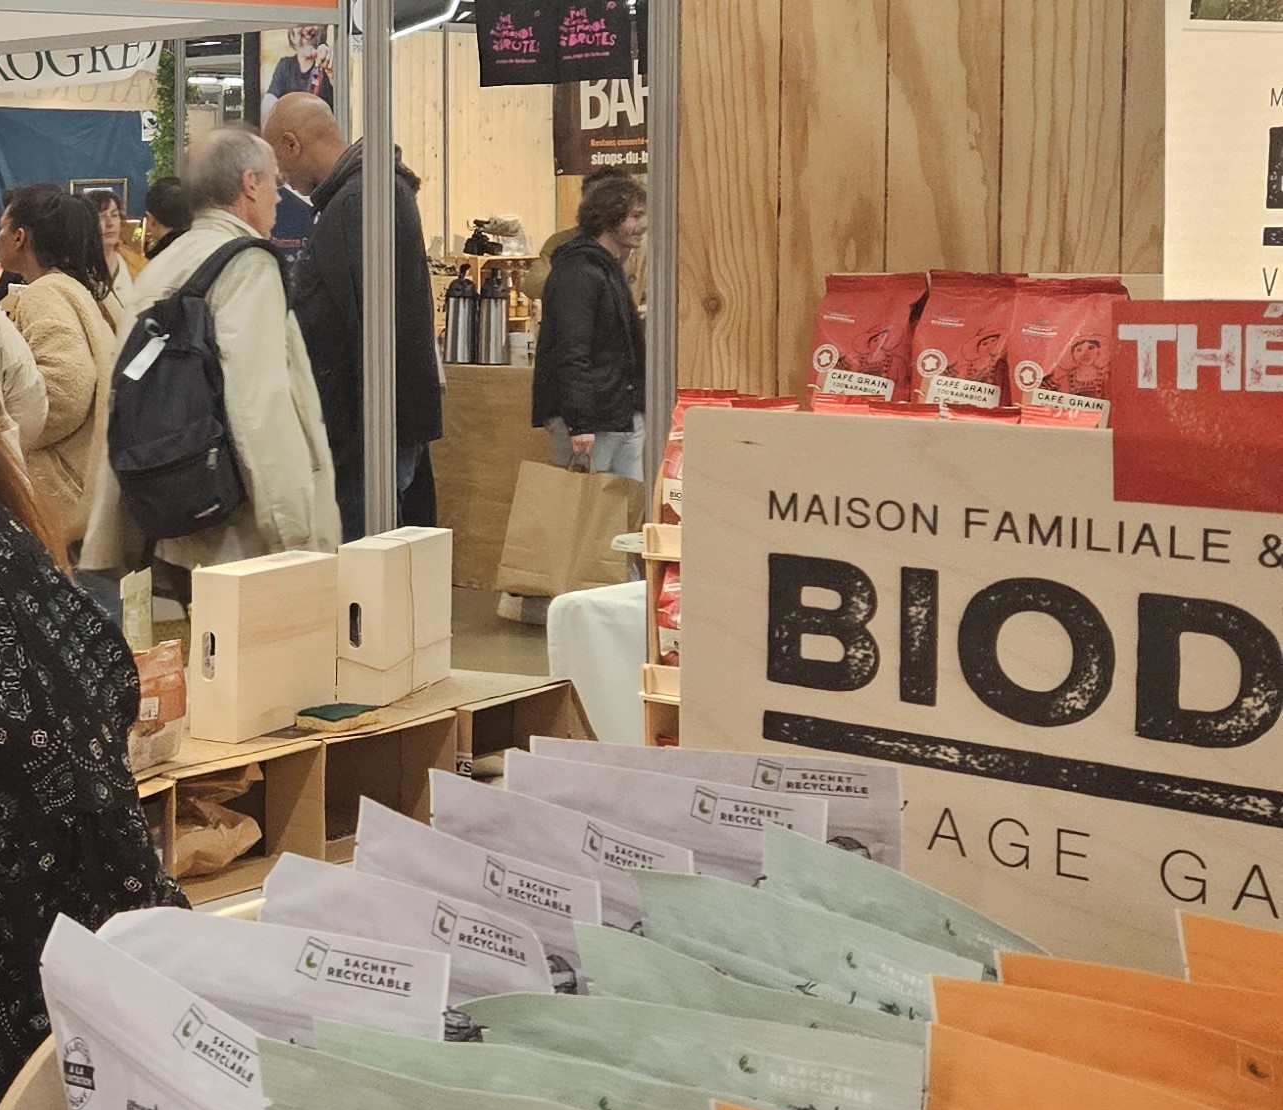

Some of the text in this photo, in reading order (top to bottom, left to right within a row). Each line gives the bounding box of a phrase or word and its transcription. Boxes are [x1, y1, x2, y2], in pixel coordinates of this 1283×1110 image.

[569, 32, 616, 47] BRUTES
[831, 371, 889, 389] CAFÉ GRAIN
[936, 378, 996, 396] CAFÉ GRAIN
[1037, 391, 1104, 411] CAFÉ GRAIN
[768, 490, 939, 536] MAISON
[964, 508, 1231, 564] FAMILIALE
[767, 552, 1283, 749] BIOD
[786, 781, 869, 794] RECYCLABLE
[801, 773, 852, 784] SACHET
[734, 804, 779, 819] SACHET
[343, 957, 396, 976] SACHET
[327, 967, 411, 992] RECYCLABLE
[212, 1036, 251, 1064] SACHET
[195, 1040, 254, 1083] RECYCLABLE
